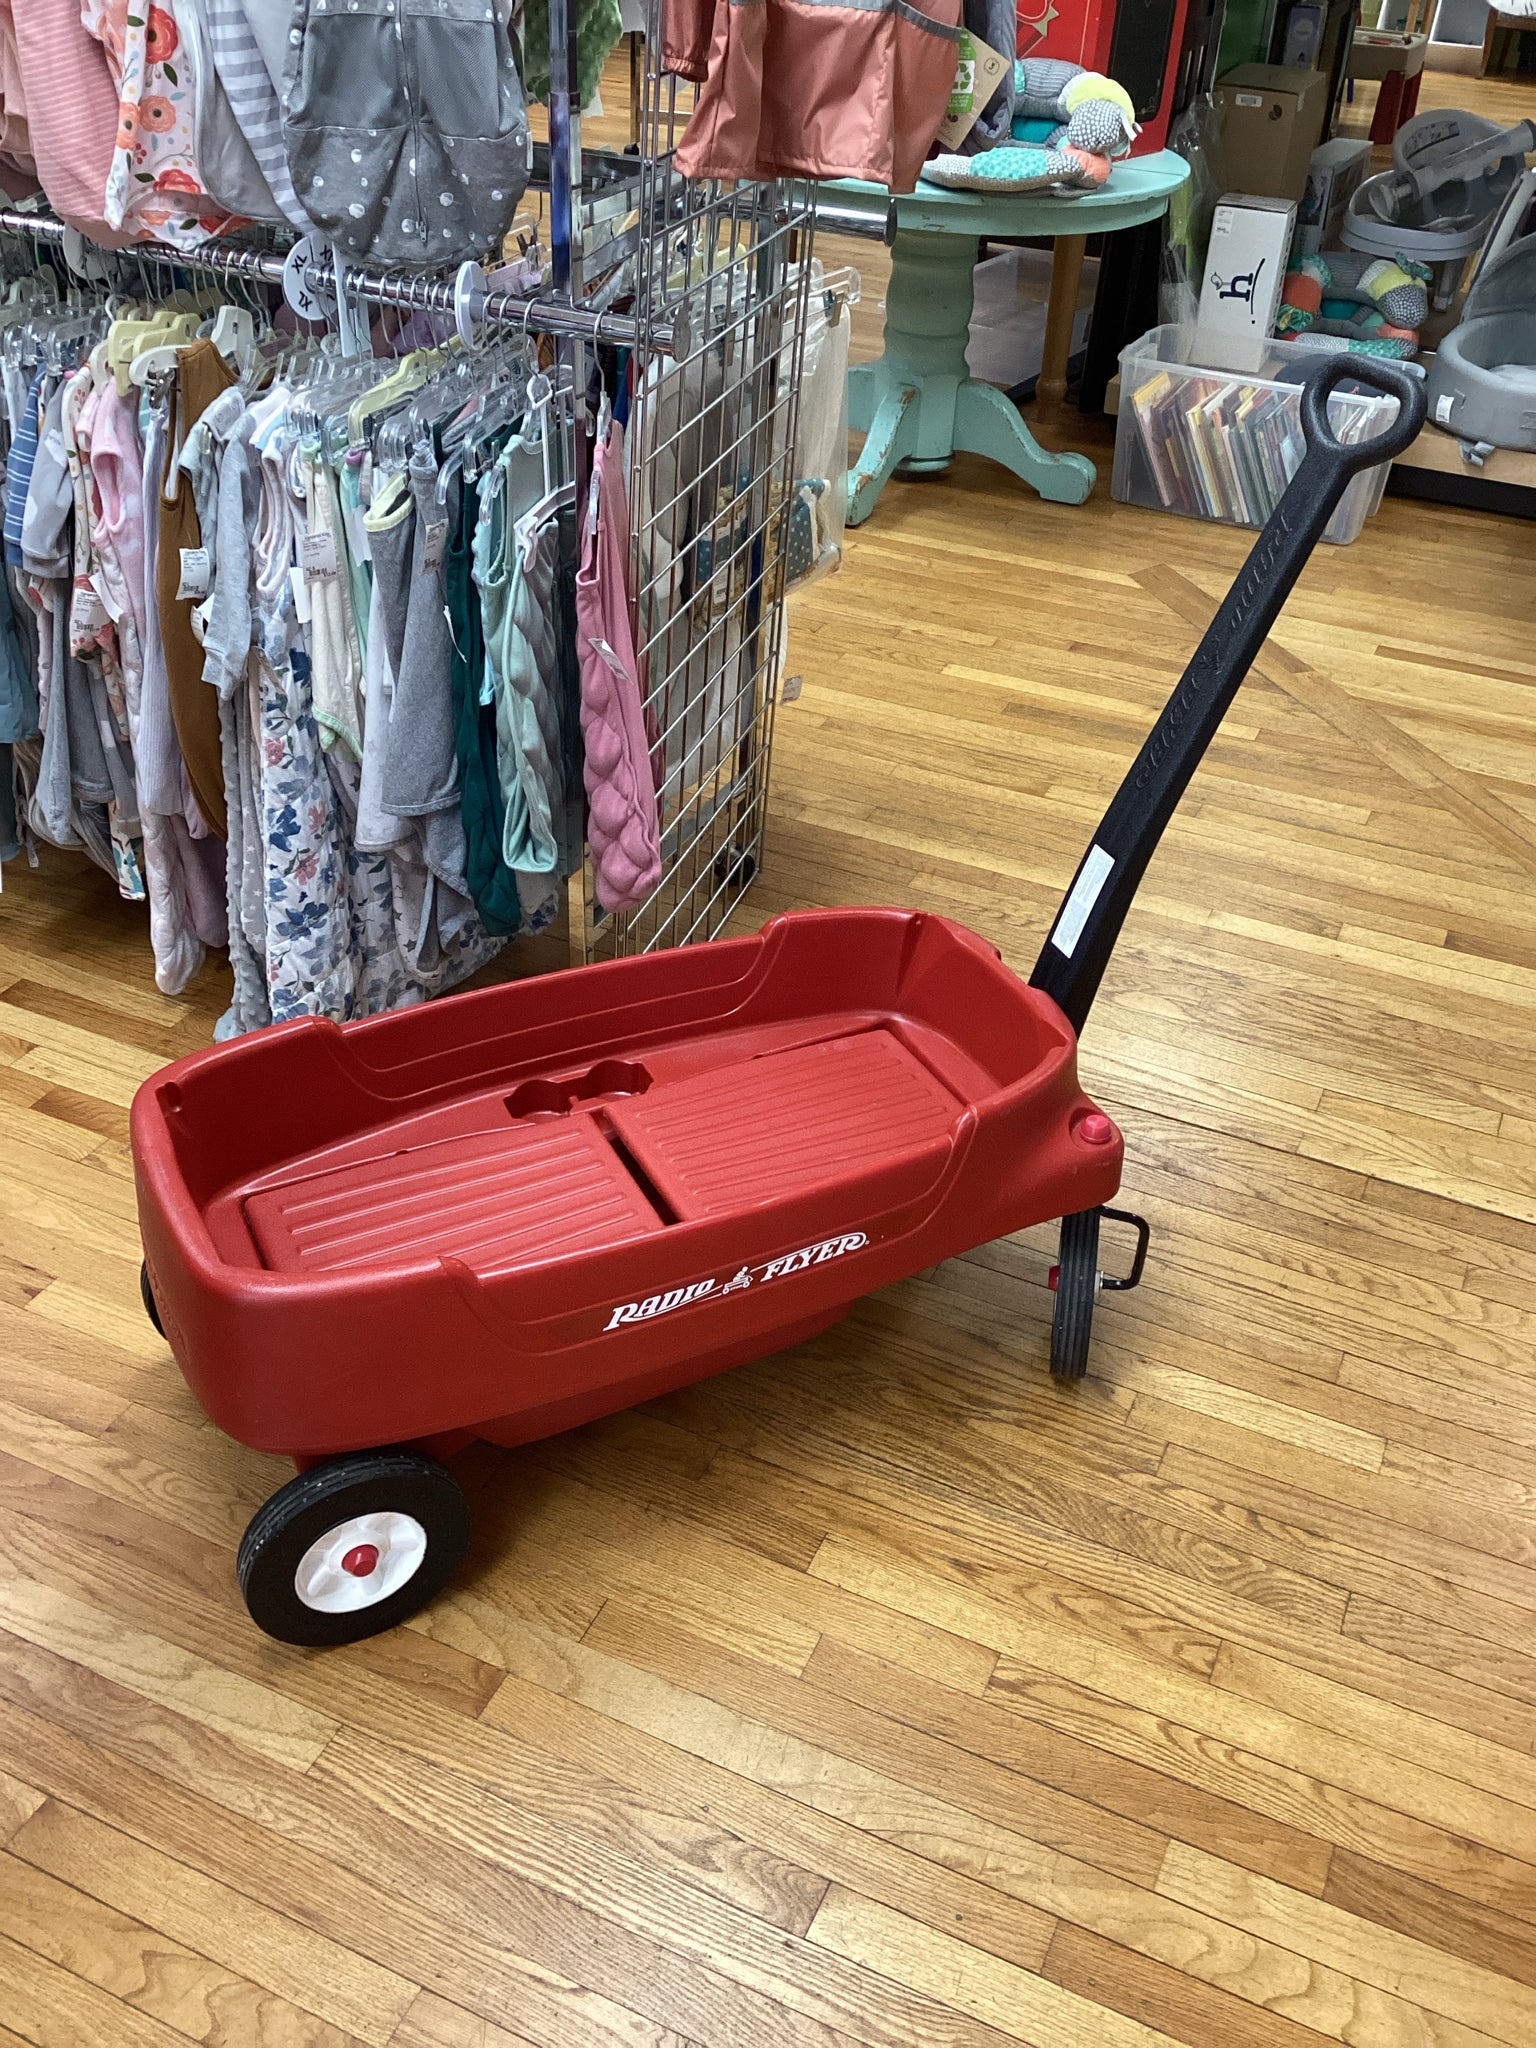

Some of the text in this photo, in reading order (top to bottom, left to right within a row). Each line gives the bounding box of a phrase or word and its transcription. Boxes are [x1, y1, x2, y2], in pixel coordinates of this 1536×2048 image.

[291, 254, 307, 274] XL
[298, 290, 312, 312] XL
[602, 1231, 867, 1332] RADIO FLYER
